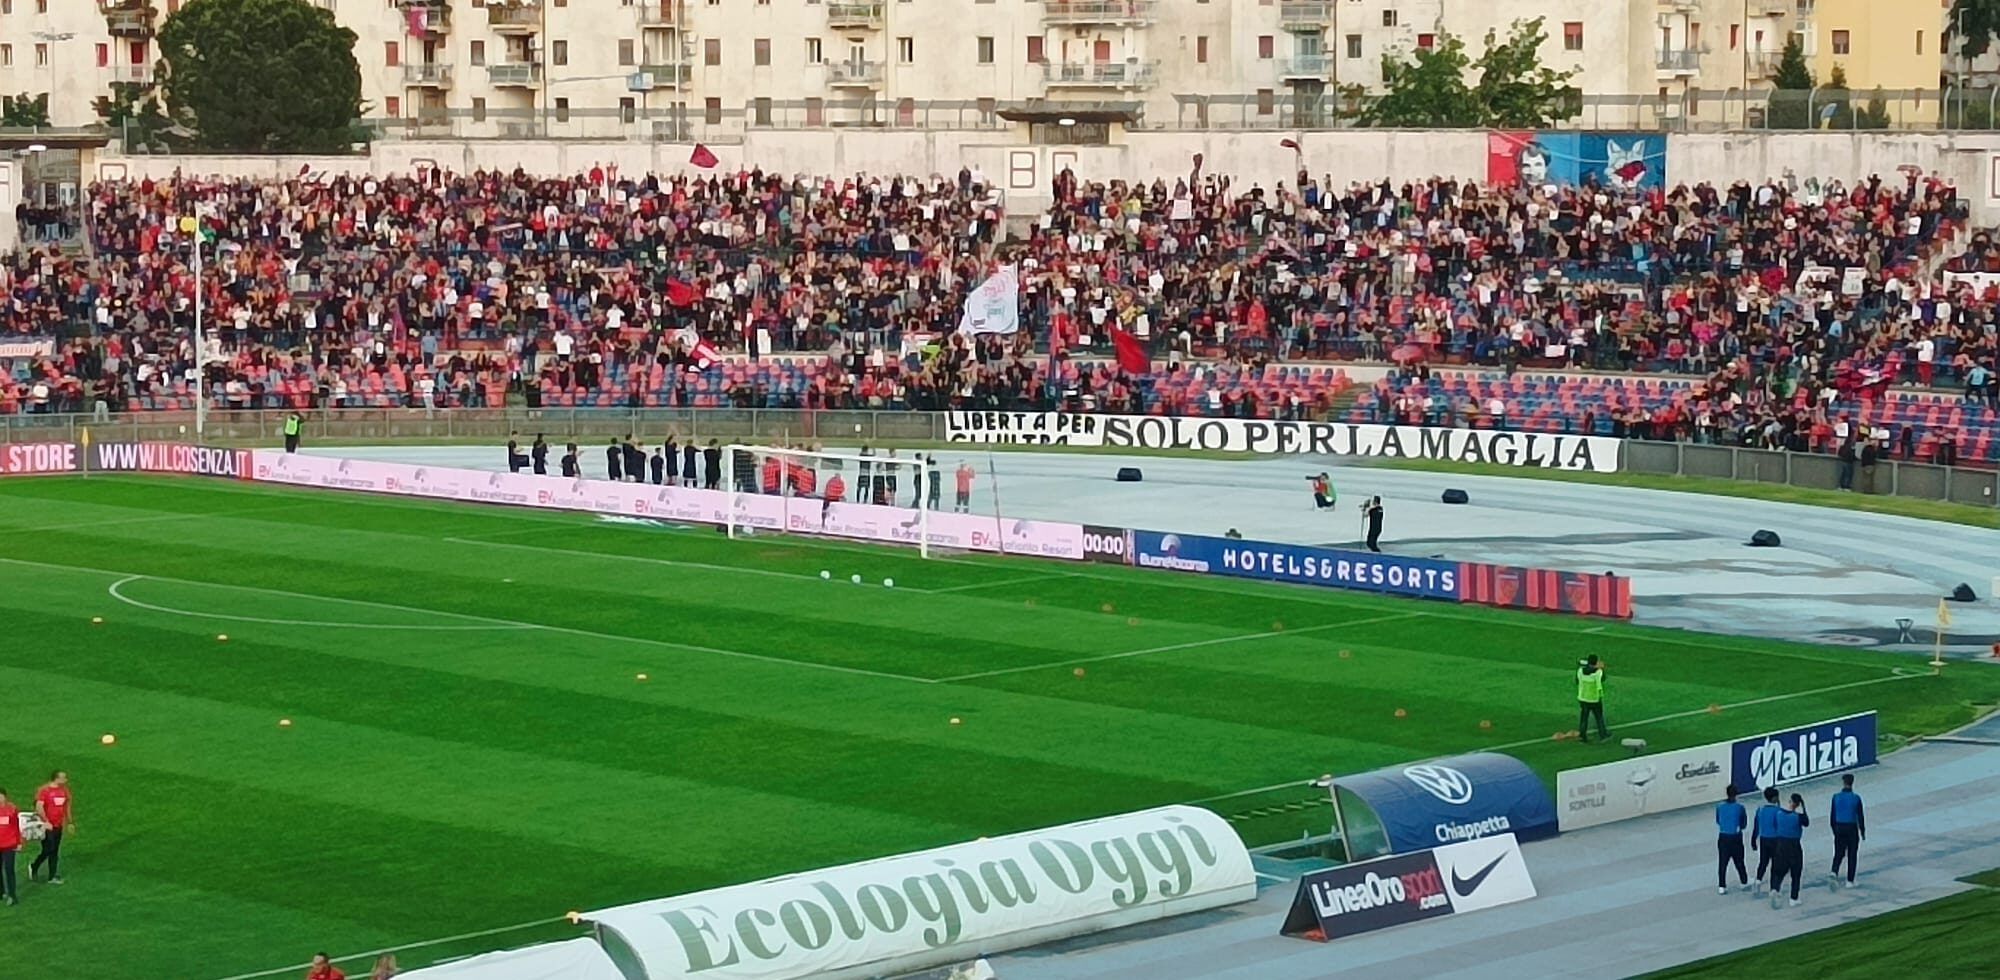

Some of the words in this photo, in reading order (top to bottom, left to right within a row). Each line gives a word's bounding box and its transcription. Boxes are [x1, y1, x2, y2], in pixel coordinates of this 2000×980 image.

[1009, 151, 1036, 189] B
[1056, 413, 1096, 434] PER
[8, 444, 76, 472] STORE
[1103, 417, 1229, 450] SOLO
[1244, 422, 1338, 454] PER
[1419, 428, 1597, 469] MAGLIA
[1084, 533, 1123, 555] 00:00
[1223, 548, 1455, 592] HOTELS&RESORTS
[1750, 726, 1859, 792] Malizia
[1435, 816, 1510, 843] Chiappetta
[662, 857, 1038, 974] Ecologia
[1028, 815, 1218, 907] Oggi
